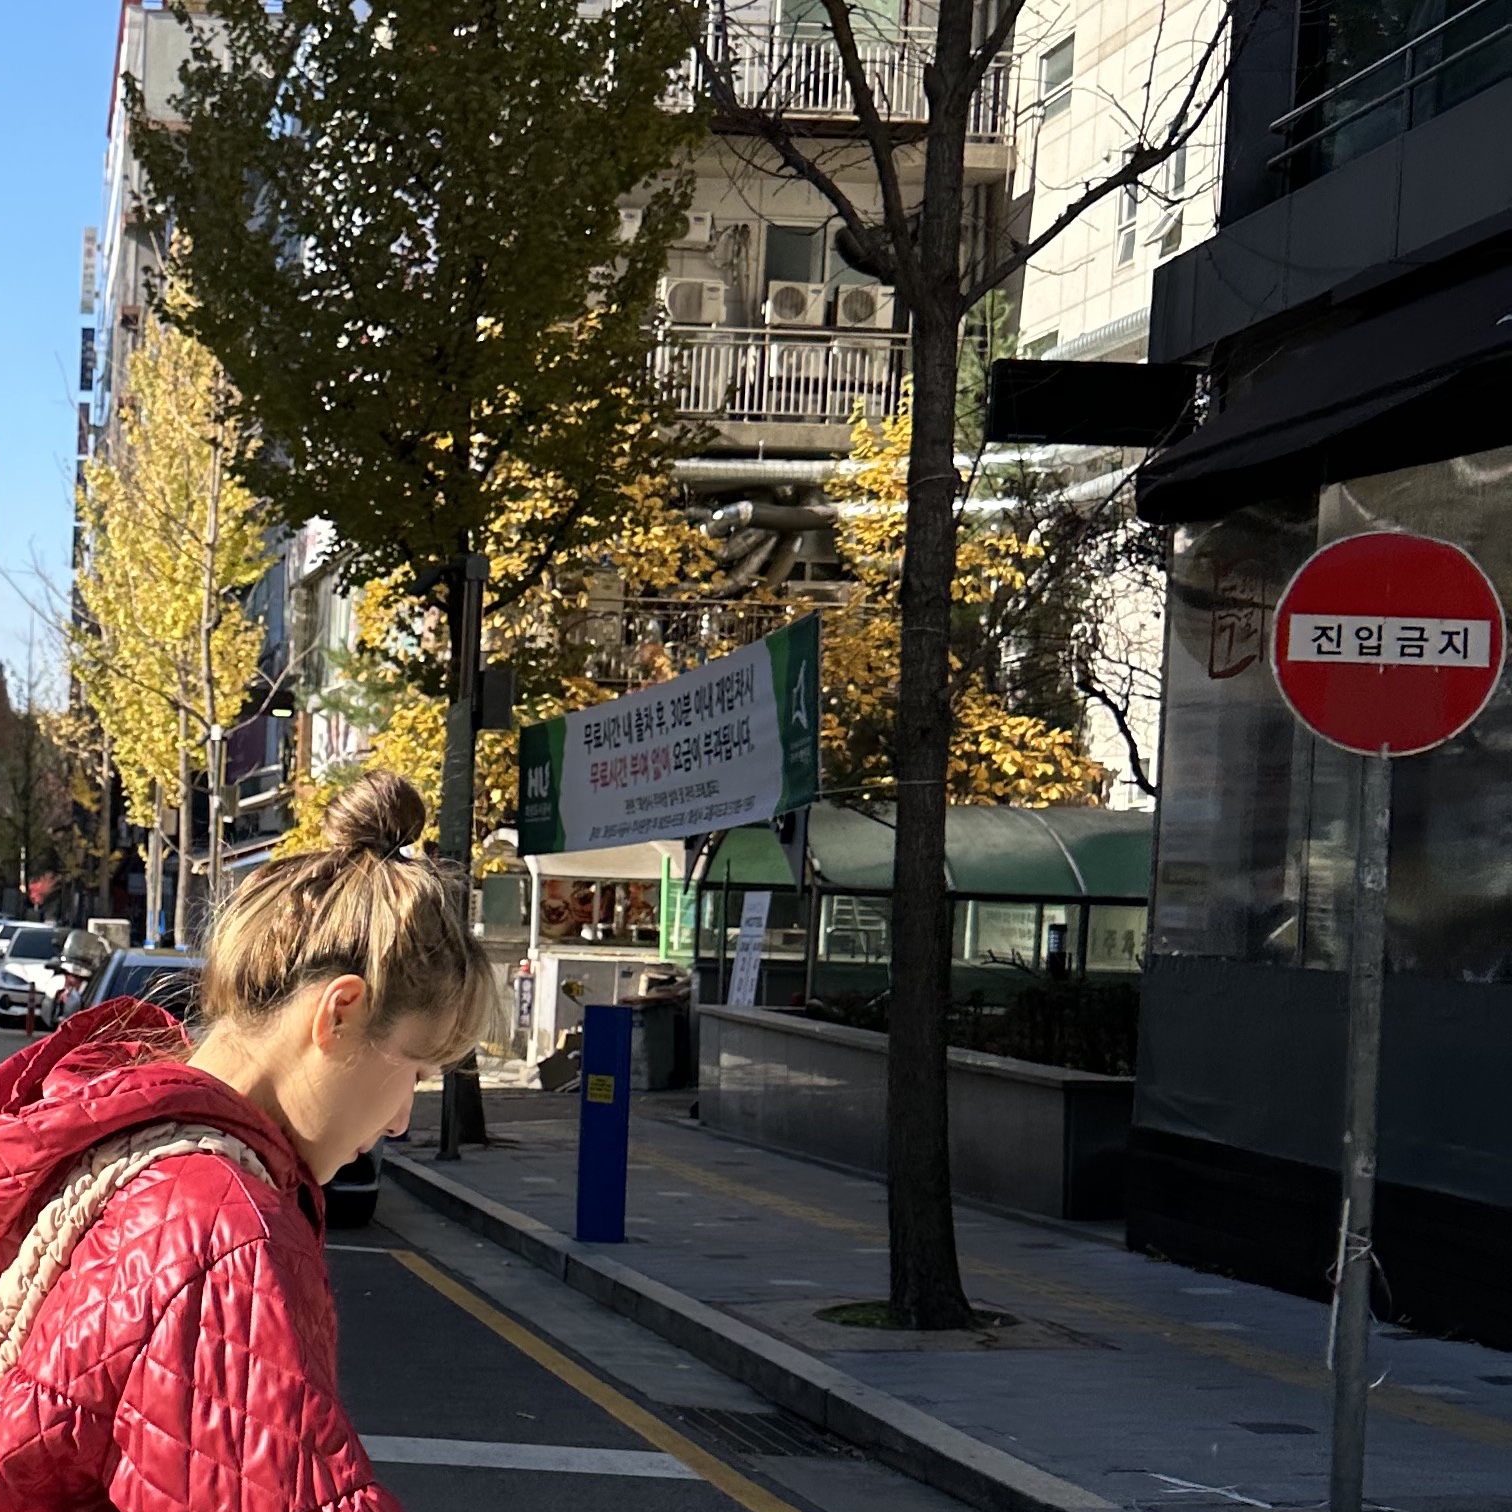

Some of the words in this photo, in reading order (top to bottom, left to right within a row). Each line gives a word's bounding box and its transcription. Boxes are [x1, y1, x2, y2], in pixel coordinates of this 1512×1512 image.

[1311, 623, 1470, 660] 진입금지
[583, 716, 621, 755] 무료시간
[622, 711, 634, 745] 내
[634, 703, 655, 742] 출차
[670, 691, 693, 728] 30분
[694, 680, 715, 722] 이내
[589, 757, 628, 794] 무료시간
[630, 750, 650, 786] 부여
[651, 746, 672, 781] 없이
[673, 734, 703, 773] 요금이
